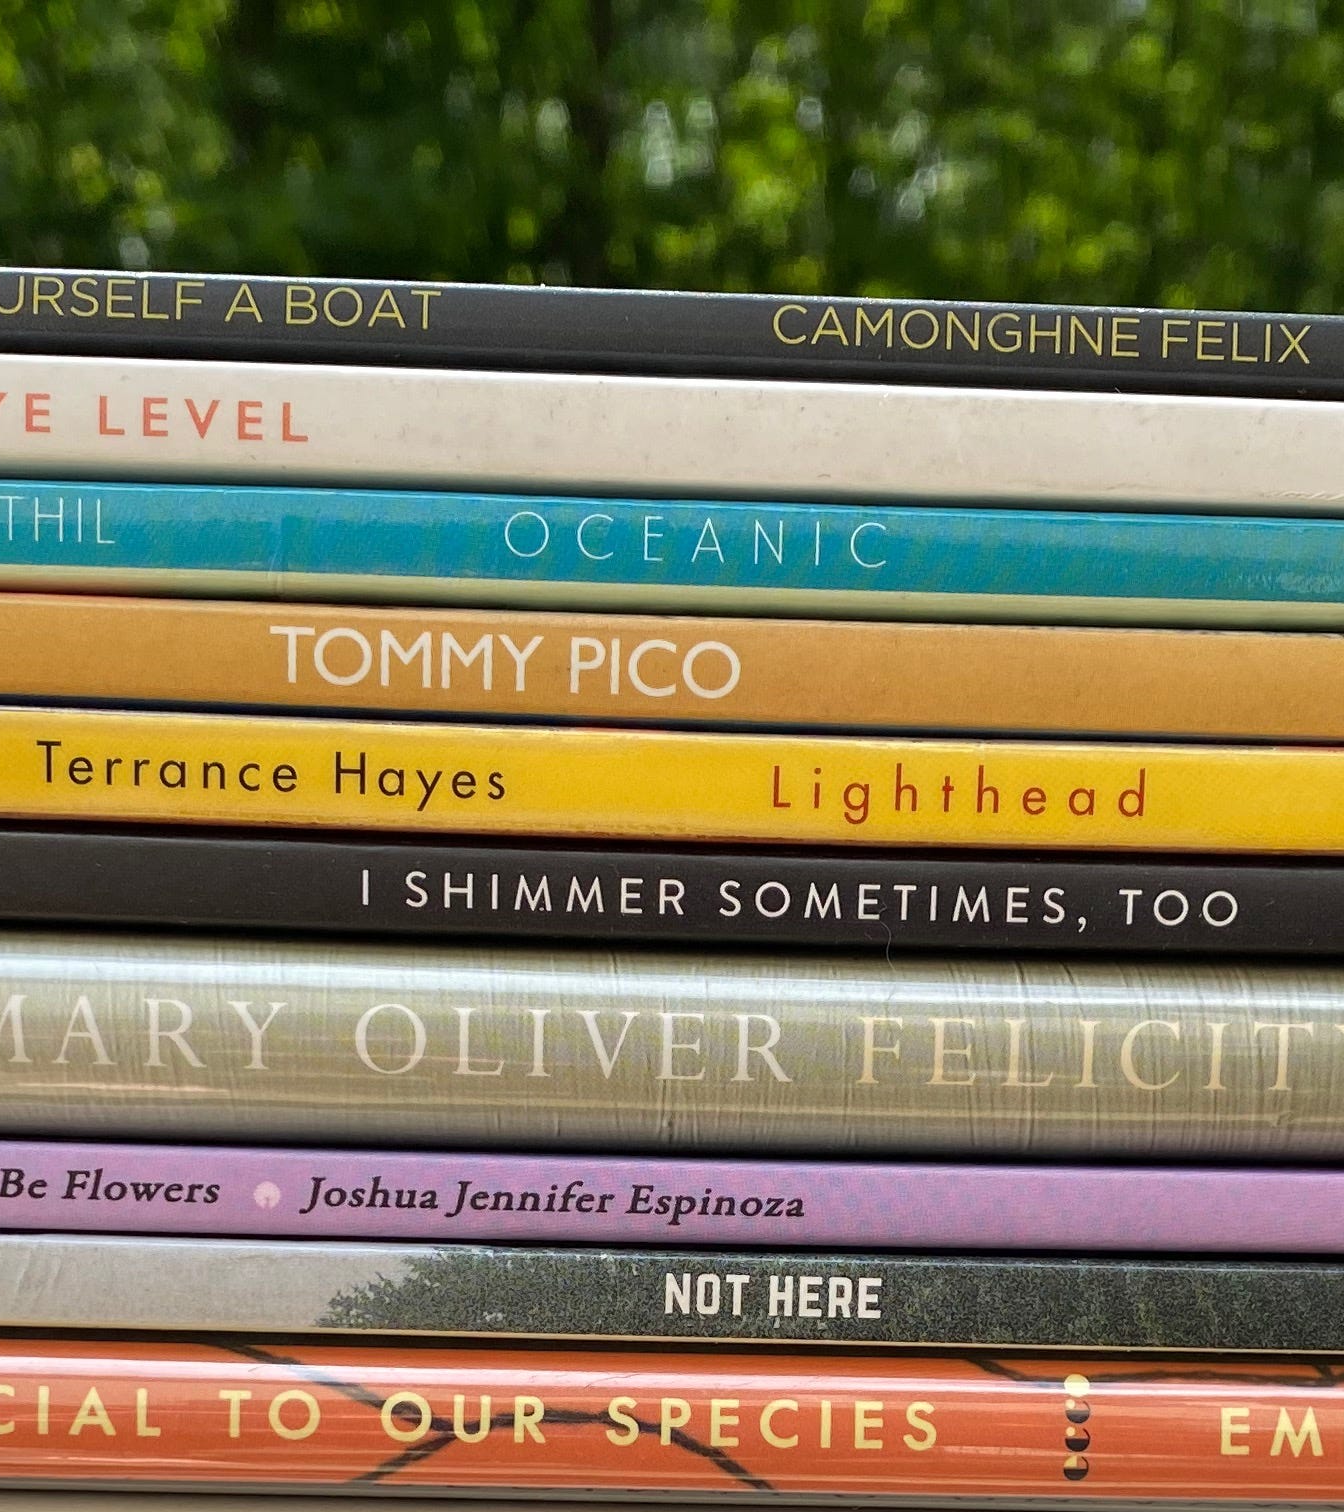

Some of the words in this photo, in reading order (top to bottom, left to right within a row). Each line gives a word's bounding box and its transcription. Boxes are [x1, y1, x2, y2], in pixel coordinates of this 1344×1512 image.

[224, 284, 262, 323] A
[287, 288, 441, 332] BOAT
[773, 303, 1138, 357] CAMONGHNE
[1162, 319, 1310, 364] FELIX
[99, 395, 308, 442] LEVEL
[503, 510, 887, 568] OCEANIC
[270, 626, 545, 695] TOMMY
[570, 636, 741, 702] PICO
[36, 740, 297, 793] Terrance
[334, 752, 507, 810] Hayes
[772, 764, 1146, 823] Lighthead
[360, 868, 370, 906] I
[406, 871, 687, 916] SHIMMER
[720, 880, 1088, 934] SOMETIMES,
[1119, 889, 1240, 928] TOO
[354, 1002, 793, 1085] OLIVER
[62, 1168, 222, 1205] Flowers
[301, 1176, 438, 1218] Joshua
[447, 1180, 615, 1220] Jennifer
[629, 1184, 805, 1226] Espinoza
[664, 1271, 751, 1317] NOT
[769, 1275, 883, 1320] HERE
[218, 1388, 320, 1442] TO
[380, 1389, 546, 1446] OUR
[605, 1395, 940, 1452] SPECIES
